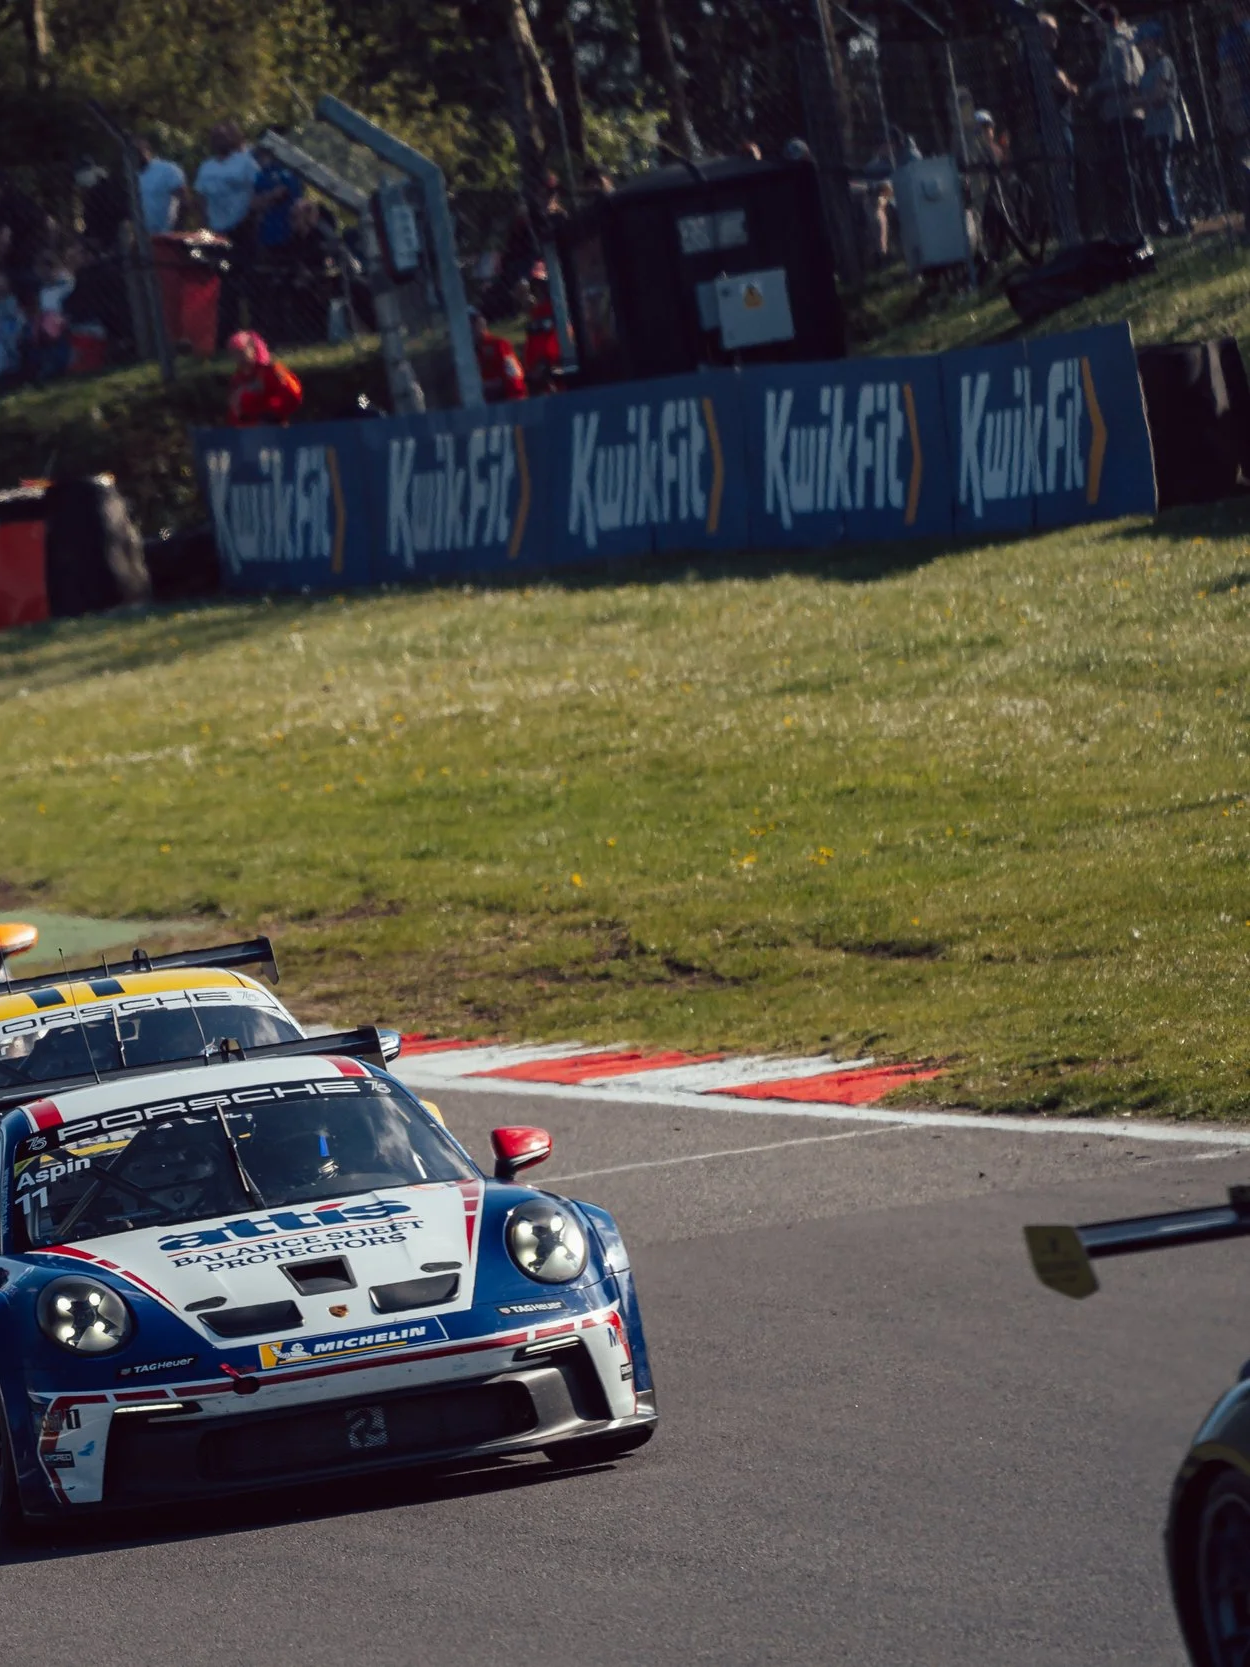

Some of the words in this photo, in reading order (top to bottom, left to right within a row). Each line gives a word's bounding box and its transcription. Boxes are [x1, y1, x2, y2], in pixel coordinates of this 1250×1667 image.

[57, 1079, 361, 1141] PORSCHE
[16, 1157, 91, 1192] Aspin
[14, 1186, 49, 1215] 11
[157, 1200, 412, 1252] attis
[171, 1234, 321, 1269] BALANCE
[326, 1219, 425, 1243] SHEET
[205, 1232, 408, 1273] PROTECTORS
[313, 1325, 427, 1354] MICHELIN
